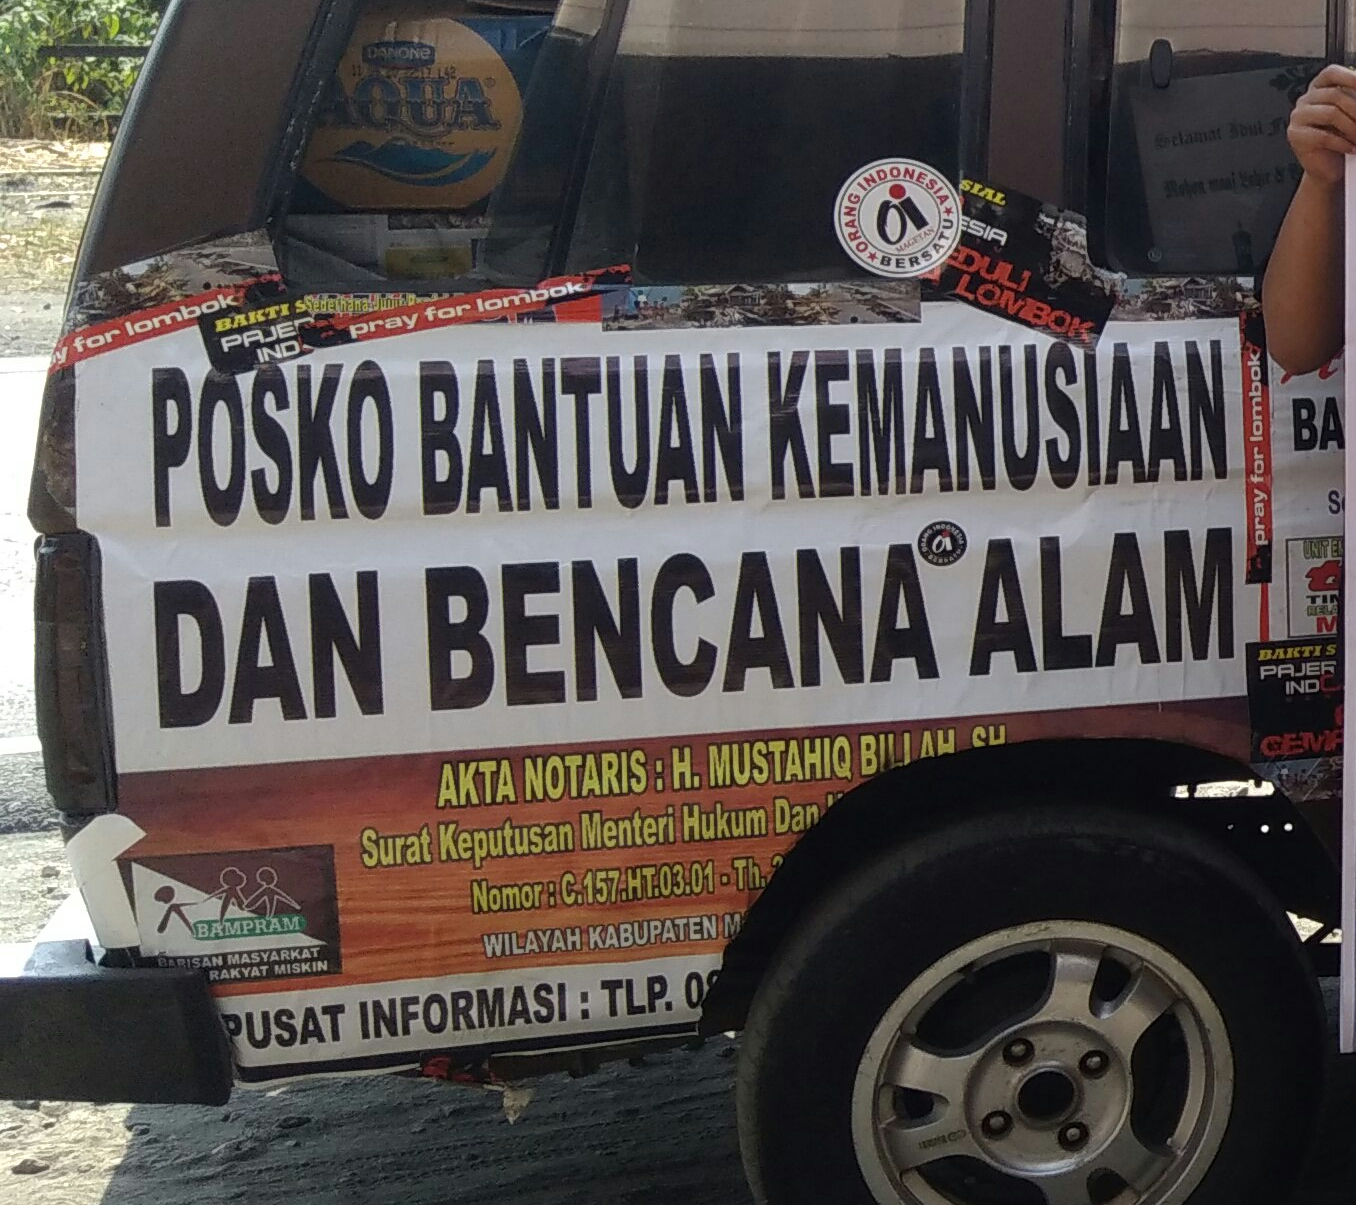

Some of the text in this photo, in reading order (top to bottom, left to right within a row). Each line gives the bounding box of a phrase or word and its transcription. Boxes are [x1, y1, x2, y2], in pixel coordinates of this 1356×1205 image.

[843, 166, 950, 253] ORANG INDONESIA
[879, 218, 954, 269] BERSATU
[73, 327, 121, 353] for
[126, 293, 240, 335] lombok
[214, 302, 291, 333] BAKTI
[350, 313, 417, 339] pray
[424, 304, 472, 324] for
[478, 281, 585, 314] lombok
[955, 274, 1095, 343] LOMBOK
[151, 339, 1229, 528] POSKO BANTUAN KEMANUSIAAN
[1247, 350, 1269, 546] pray for lombok
[154, 527, 1235, 729] DAN BENCANA ALAM
[1257, 646, 1323, 662] BAKTI
[437, 759, 516, 808] AKTA
[525, 749, 648, 801] NOTARIS
[671, 746, 700, 790] H.
[709, 734, 852, 787] MUSTAHIQ
[361, 826, 432, 867] Surat
[439, 816, 575, 869] Keputusan
[580, 806, 675, 850] Menteri
[682, 801, 768, 842] Hukum
[773, 797, 820, 834] Dan
[471, 879, 543, 914] Nomor
[198, 918, 301, 939] BAMPRAM
[227, 947, 321, 965] MASYARKAT
[483, 914, 745, 958] WILAYAH KABUPATEN M
[209, 960, 328, 981] RAKYAT MISKIN
[222, 1003, 346, 1050] PUSAT
[360, 982, 567, 1040] INFORMASI
[600, 974, 674, 1018] TLP.
